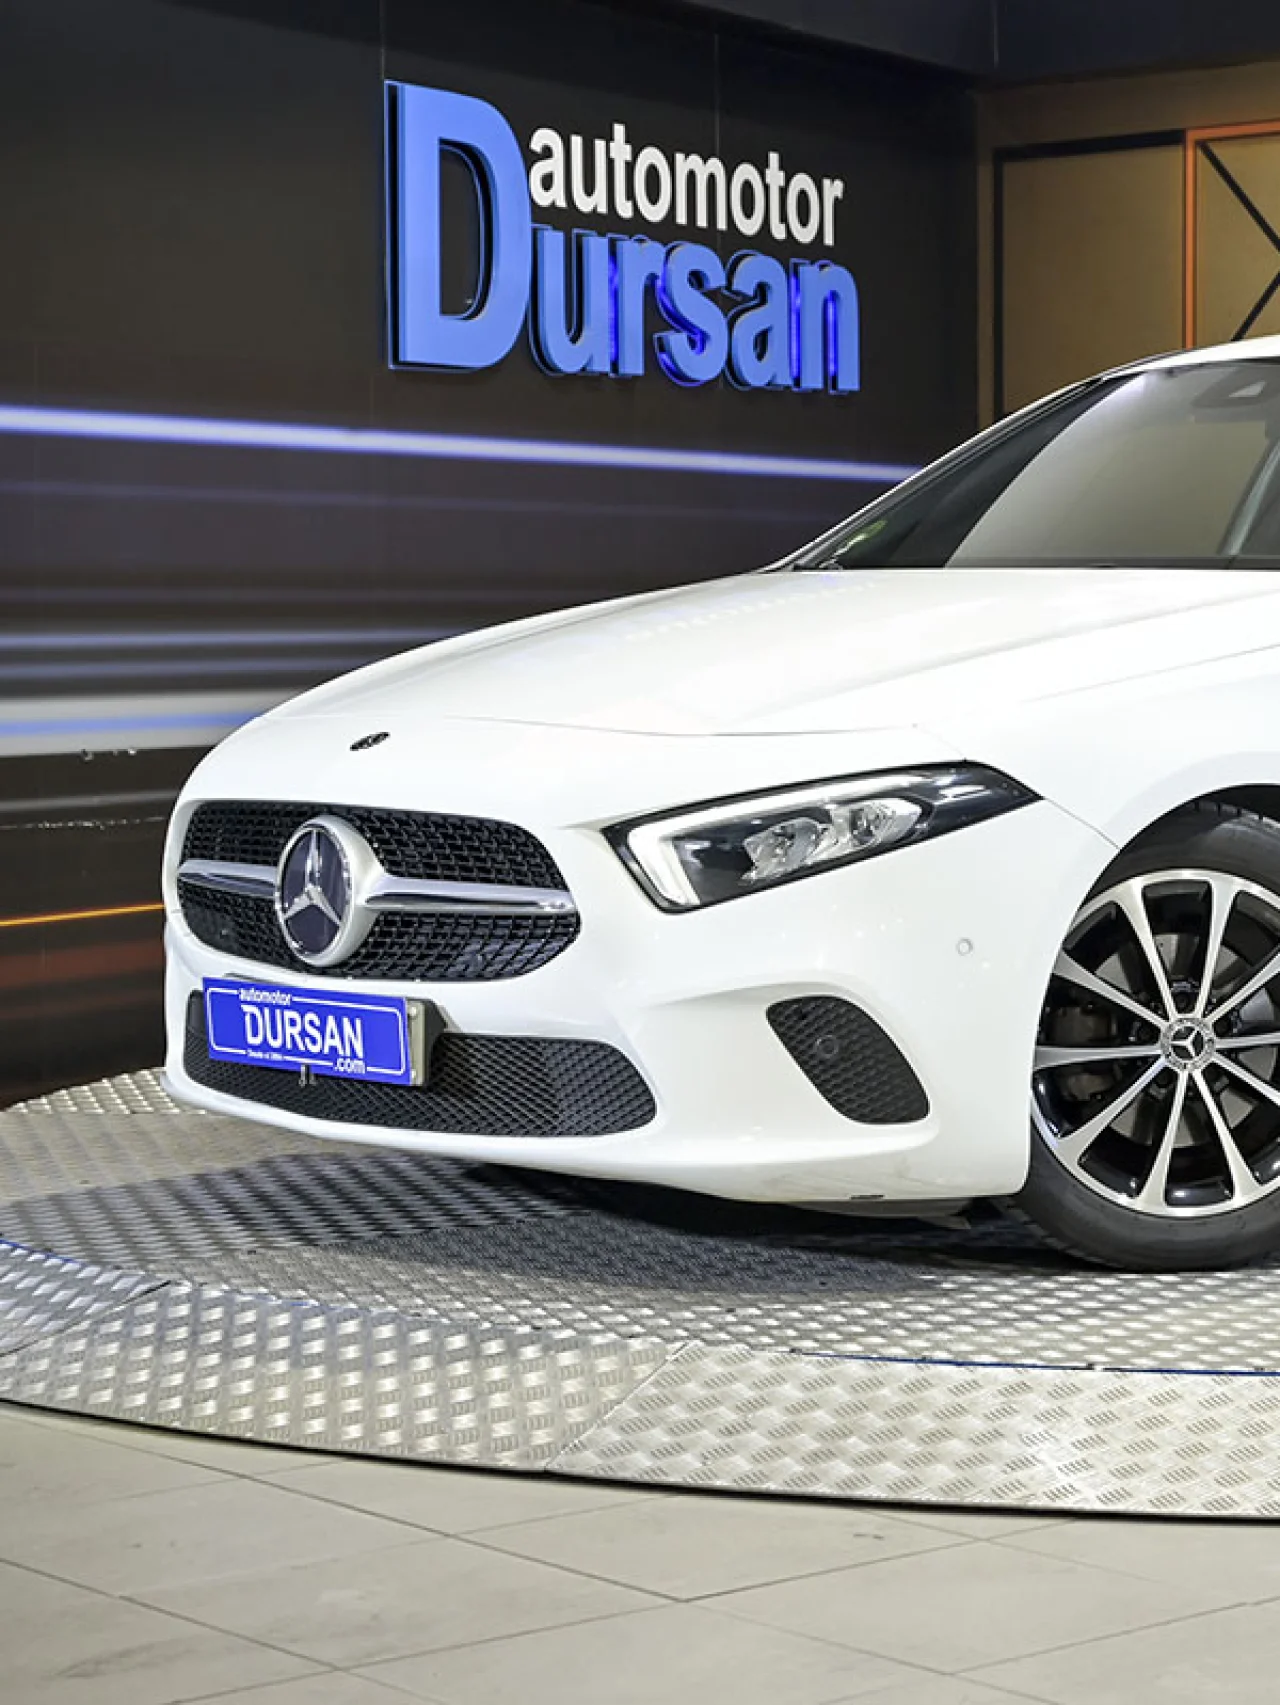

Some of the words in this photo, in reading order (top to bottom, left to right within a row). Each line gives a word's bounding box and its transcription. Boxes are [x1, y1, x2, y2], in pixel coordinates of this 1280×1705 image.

[529, 122, 845, 247] automotor
[384, 79, 861, 393] Dursan
[239, 987, 292, 1006] automotor
[240, 1004, 364, 1059] DURSAN
[332, 1057, 366, 1074] .com
